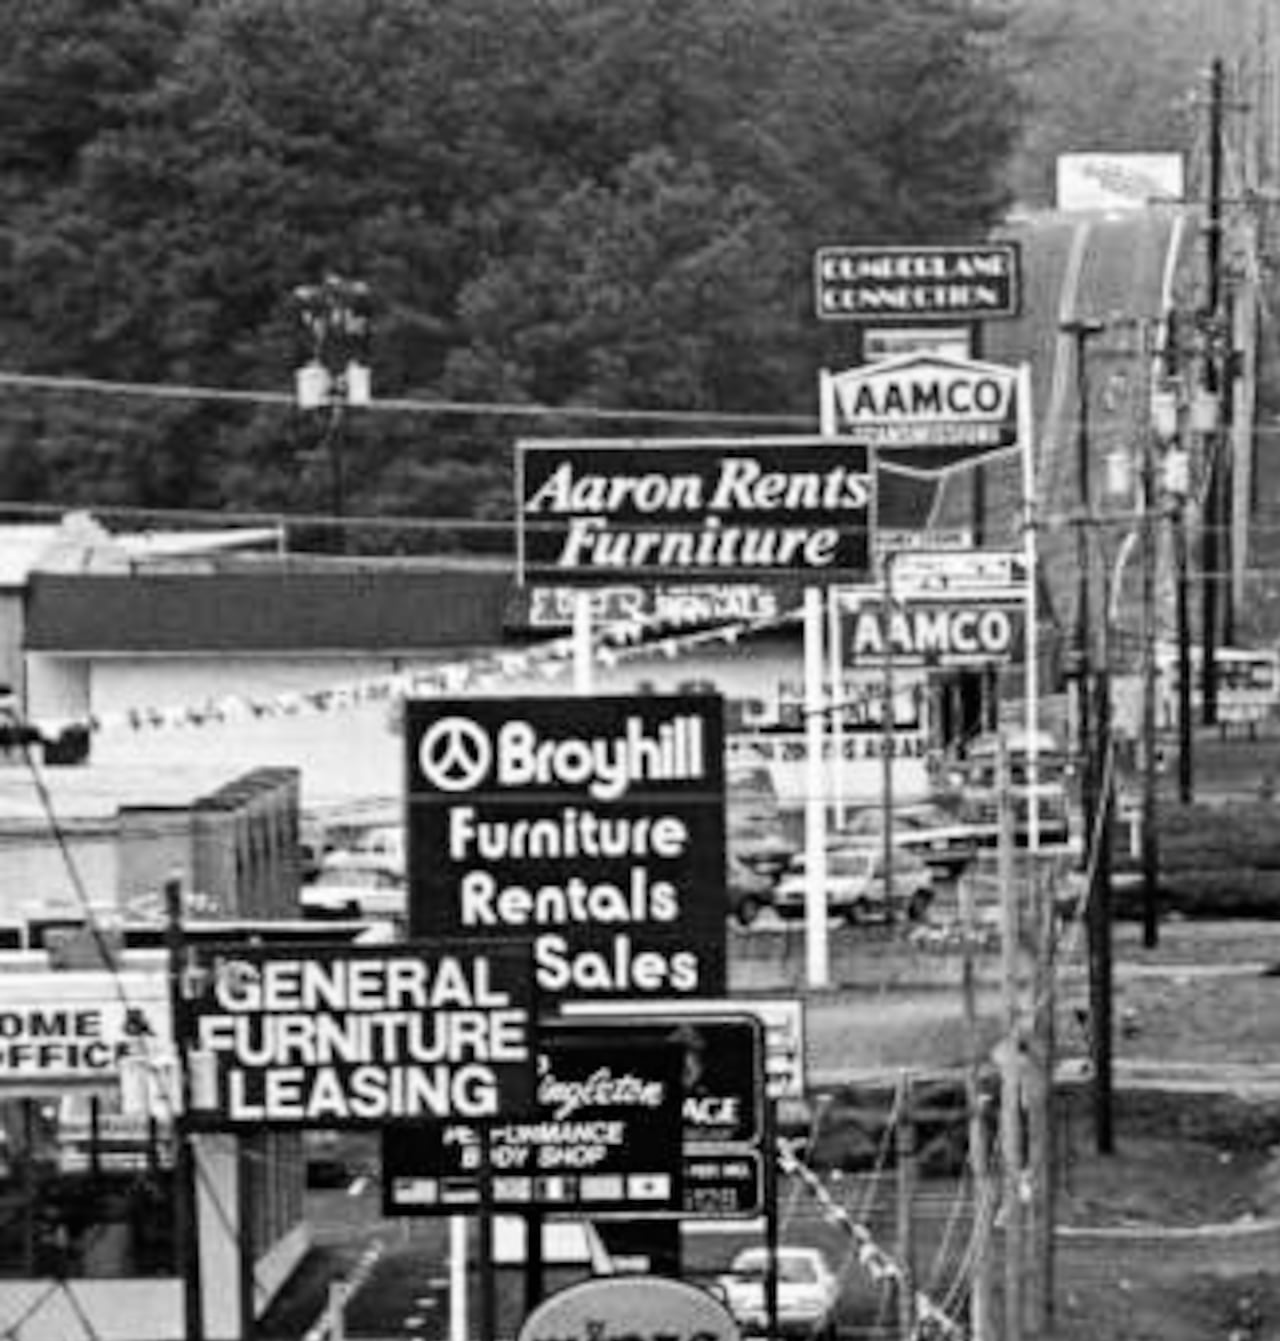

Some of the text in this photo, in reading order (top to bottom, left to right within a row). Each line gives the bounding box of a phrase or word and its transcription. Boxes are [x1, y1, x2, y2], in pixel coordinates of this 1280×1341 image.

[853, 379, 1002, 416] AAMCO
[525, 457, 871, 513] Aaron Rents
[557, 515, 839, 567] Furniture
[853, 610, 1011, 652] AAMCO
[497, 714, 704, 800] Broyhill
[449, 806, 688, 860] Furniture
[461, 865, 679, 925] Rentals
[215, 956, 509, 1012] GENERAL
[535, 932, 699, 992] Sales
[123, 1008, 157, 1038] &
[199, 1009, 529, 1067] FURNITURE
[228, 1063, 499, 1121] LEASING
